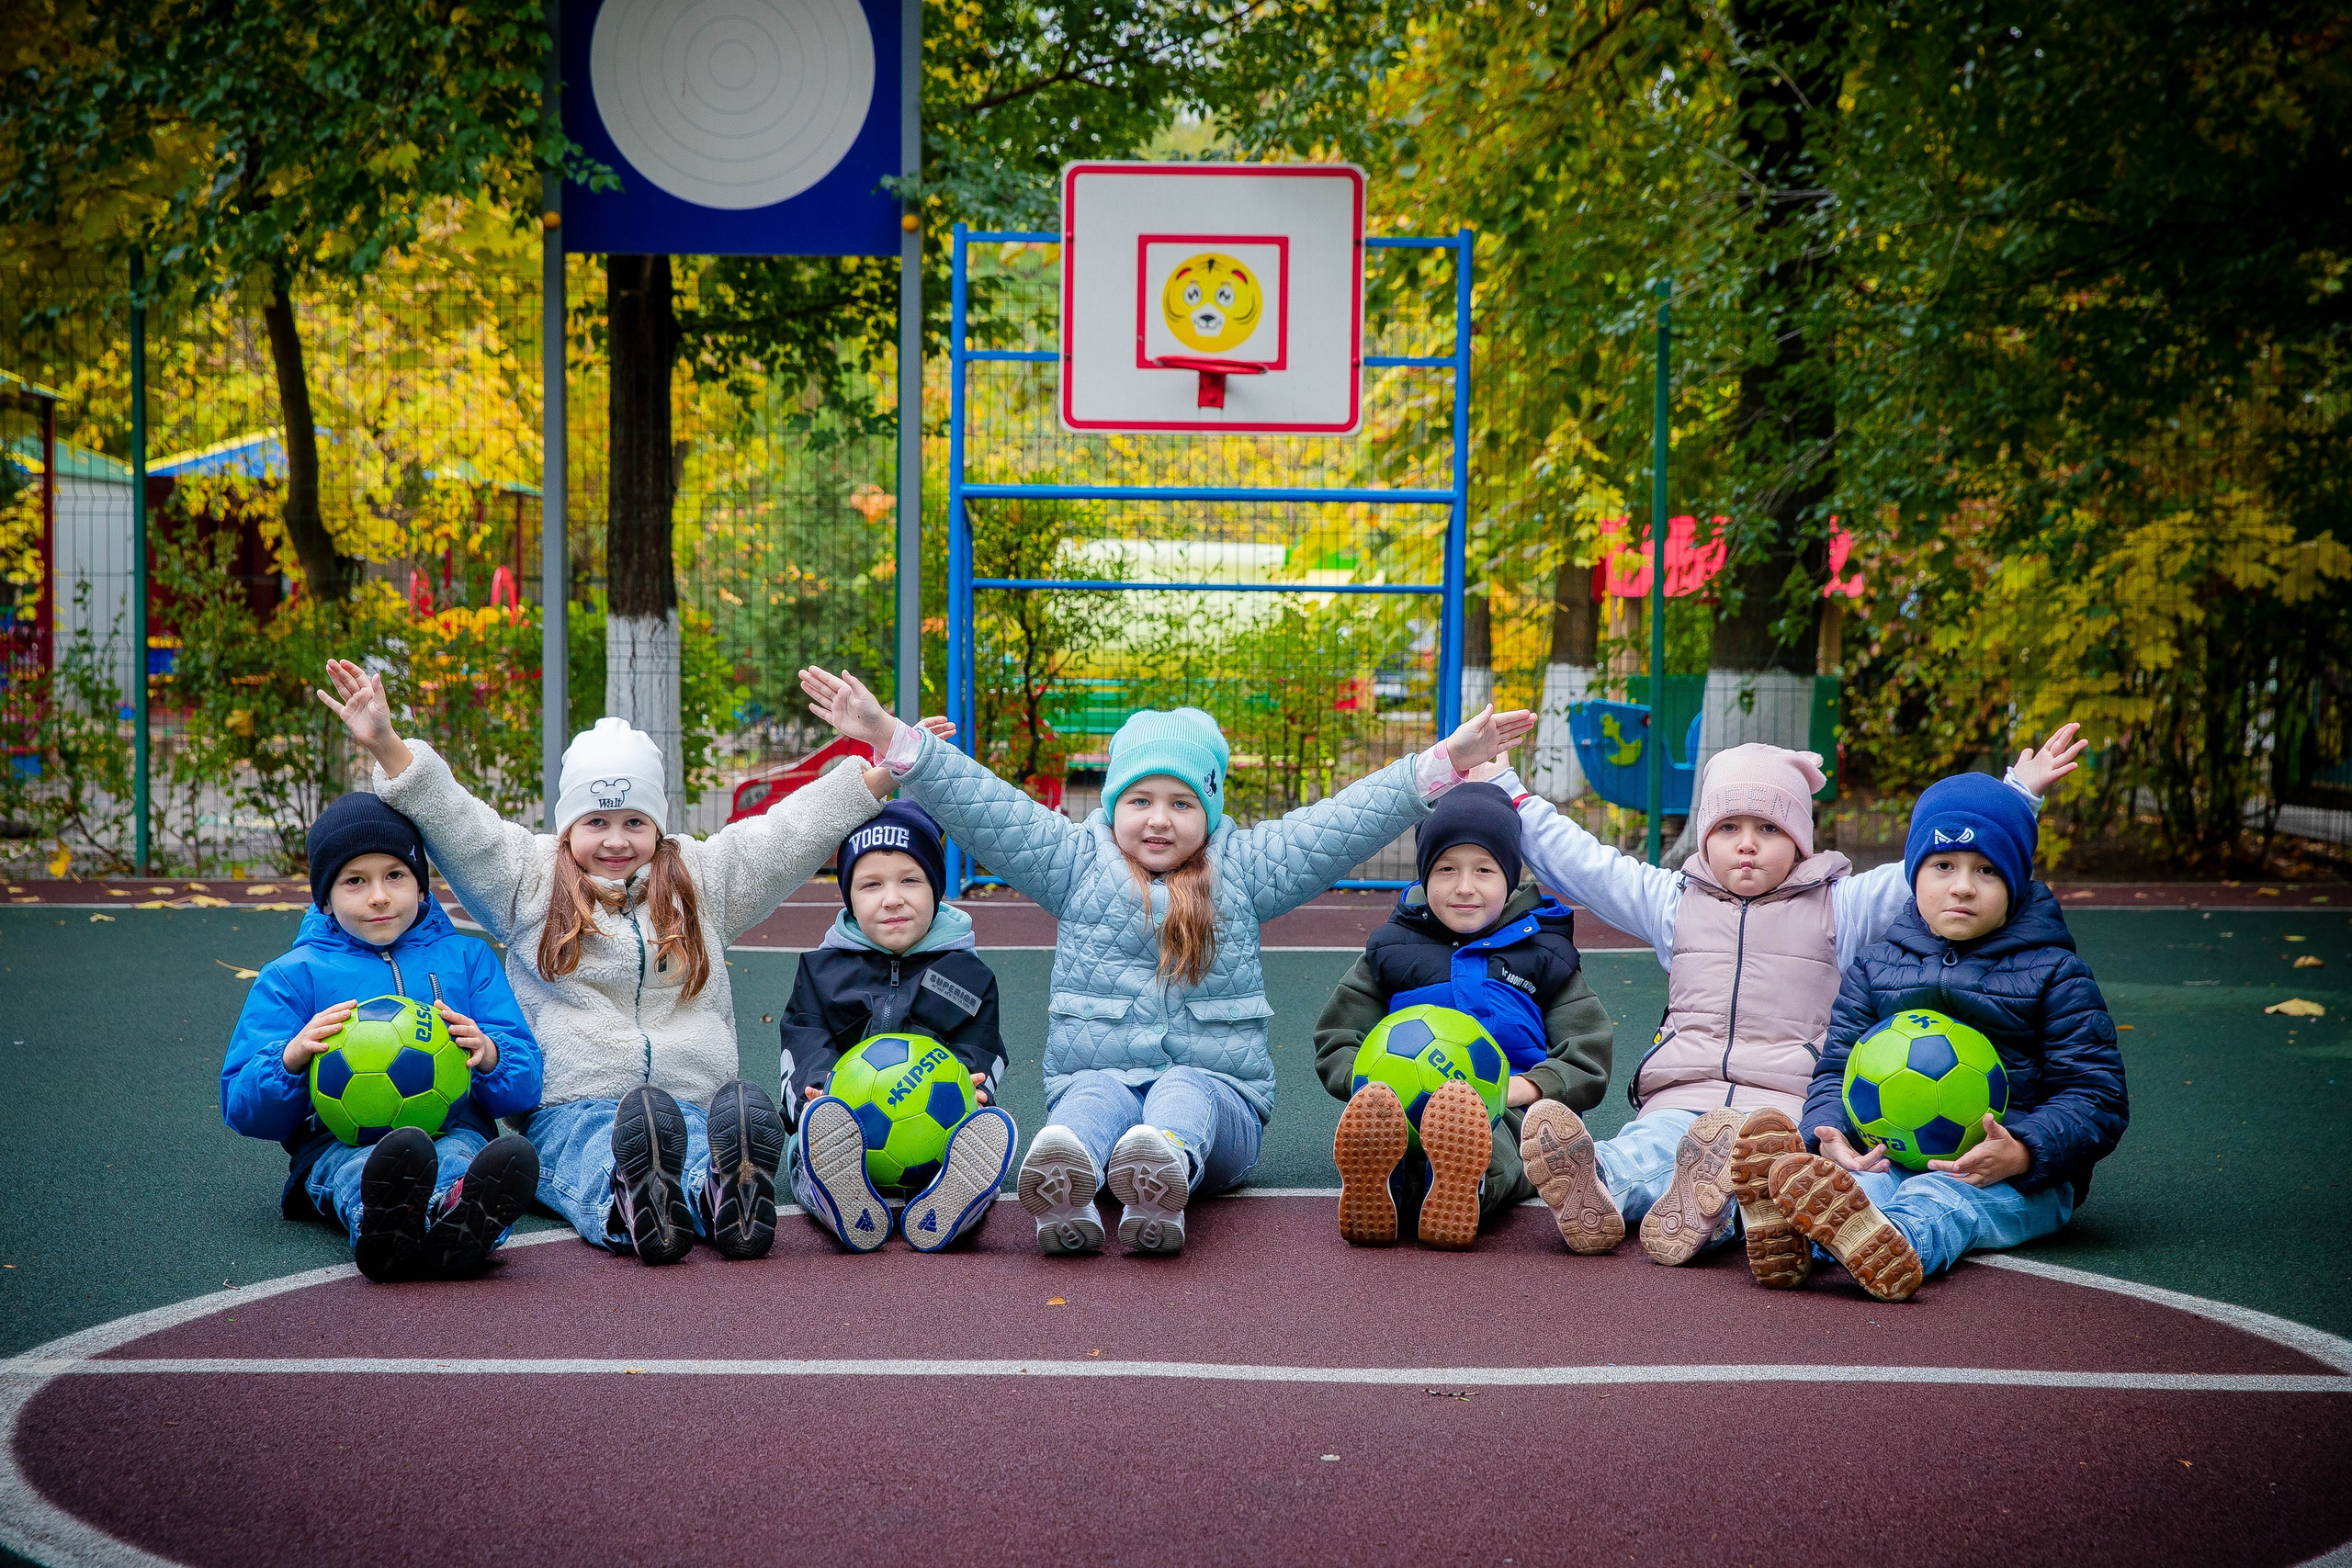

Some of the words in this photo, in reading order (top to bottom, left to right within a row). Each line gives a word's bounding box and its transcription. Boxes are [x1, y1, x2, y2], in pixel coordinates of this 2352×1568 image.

[598, 797, 622, 808] Walt
[848, 826, 910, 855] VOGUE
[929, 974, 978, 1007] SUPERIOR
